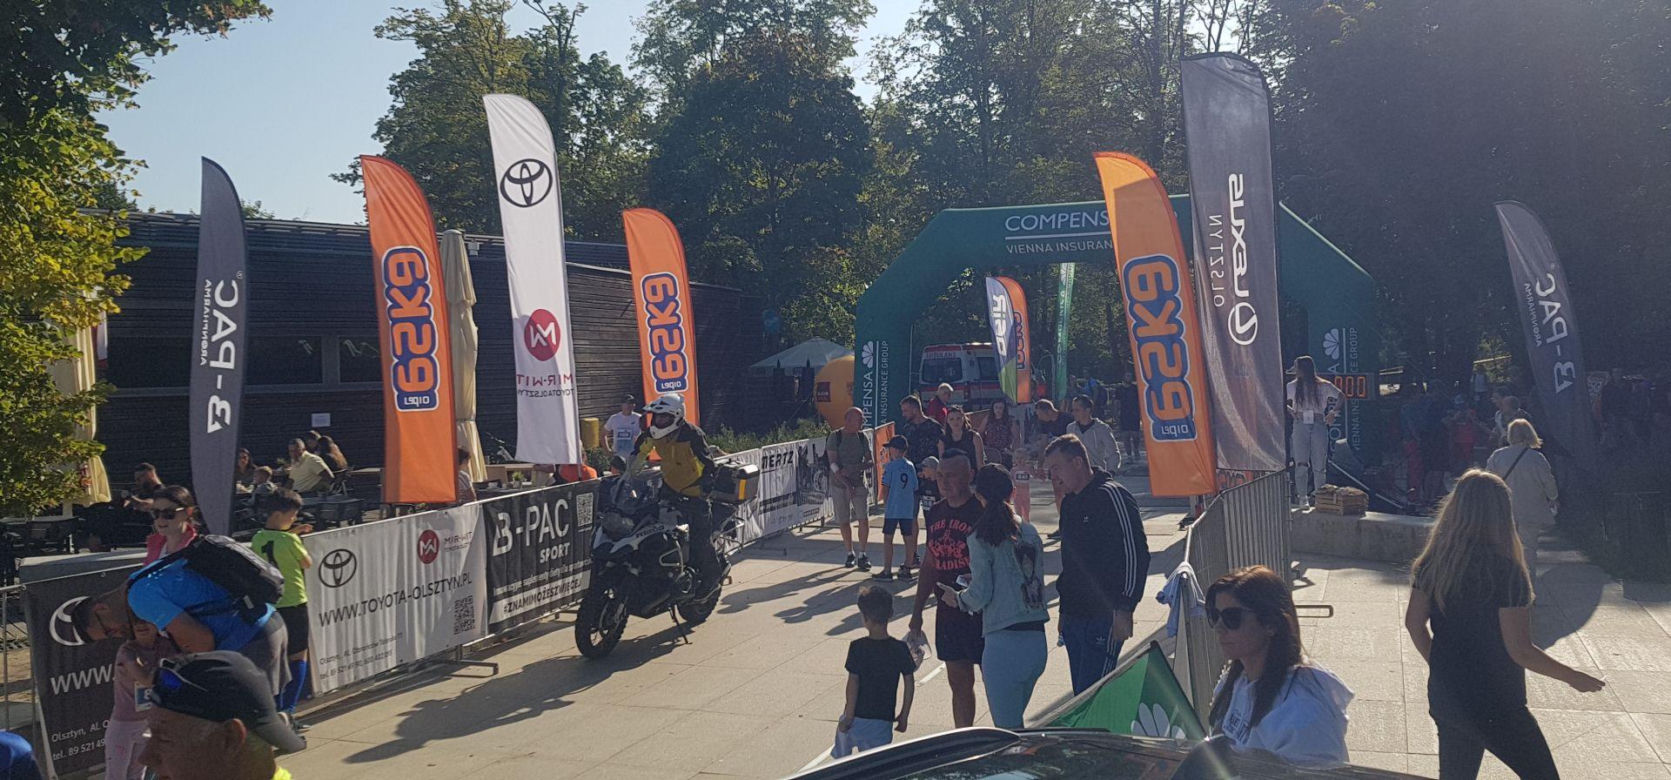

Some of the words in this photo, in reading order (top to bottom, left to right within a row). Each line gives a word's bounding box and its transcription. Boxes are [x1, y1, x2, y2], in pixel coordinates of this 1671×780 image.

[1004, 210, 1109, 232] COMPENS
[1006, 244, 1053, 254] VIENNA
[1056, 240, 1113, 252] INSURAN
[880, 340, 888, 369] GROUP
[1350, 327, 1359, 359] GROUP
[862, 371, 873, 427] MPENSA
[880, 370, 888, 418] INSURANCE
[900, 472, 909, 489] 9
[492, 498, 570, 557] B-PAC
[539, 542, 570, 564] SPORT
[318, 572, 473, 628] WWW.TOYOTA-OLSZTYN.PL
[50, 663, 116, 696] WWW.
[51, 728, 87, 744] Olsztyn,
[68, 745, 79, 756] 89
[80, 742, 95, 754] 521
